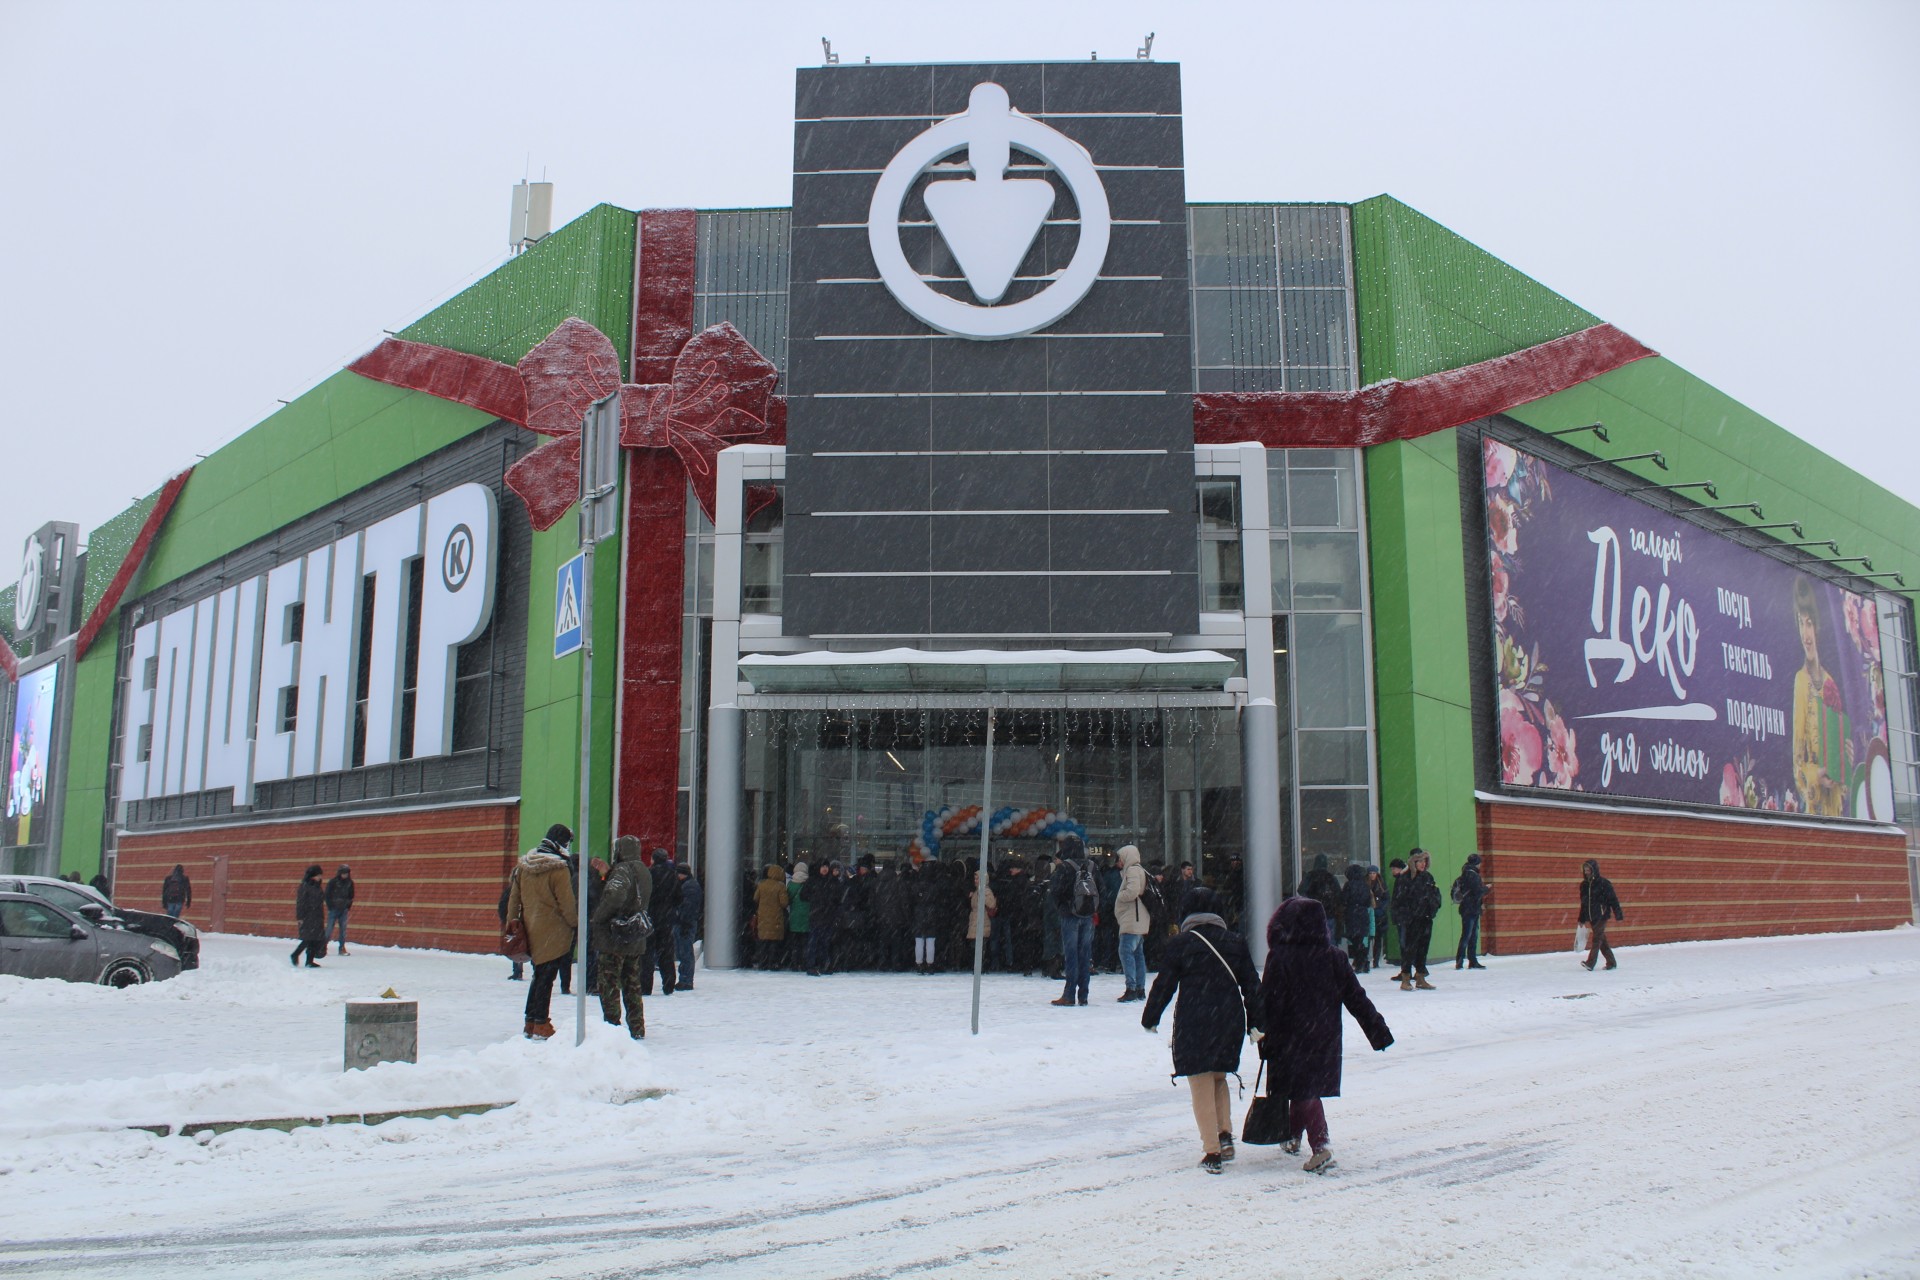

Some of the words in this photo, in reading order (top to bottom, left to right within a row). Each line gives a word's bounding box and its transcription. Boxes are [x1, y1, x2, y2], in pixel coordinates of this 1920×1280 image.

[1630, 528, 1683, 577] галереї
[1584, 526, 1699, 700] Деко
[1717, 586, 1752, 630] посуд
[121, 483, 498, 806] ЕПІЦЕНТР
[1722, 642, 1773, 681] текстиль
[1727, 698, 1786, 742] подарунки
[1601, 732, 1641, 788] для
[1650, 738, 1710, 780] жінок
